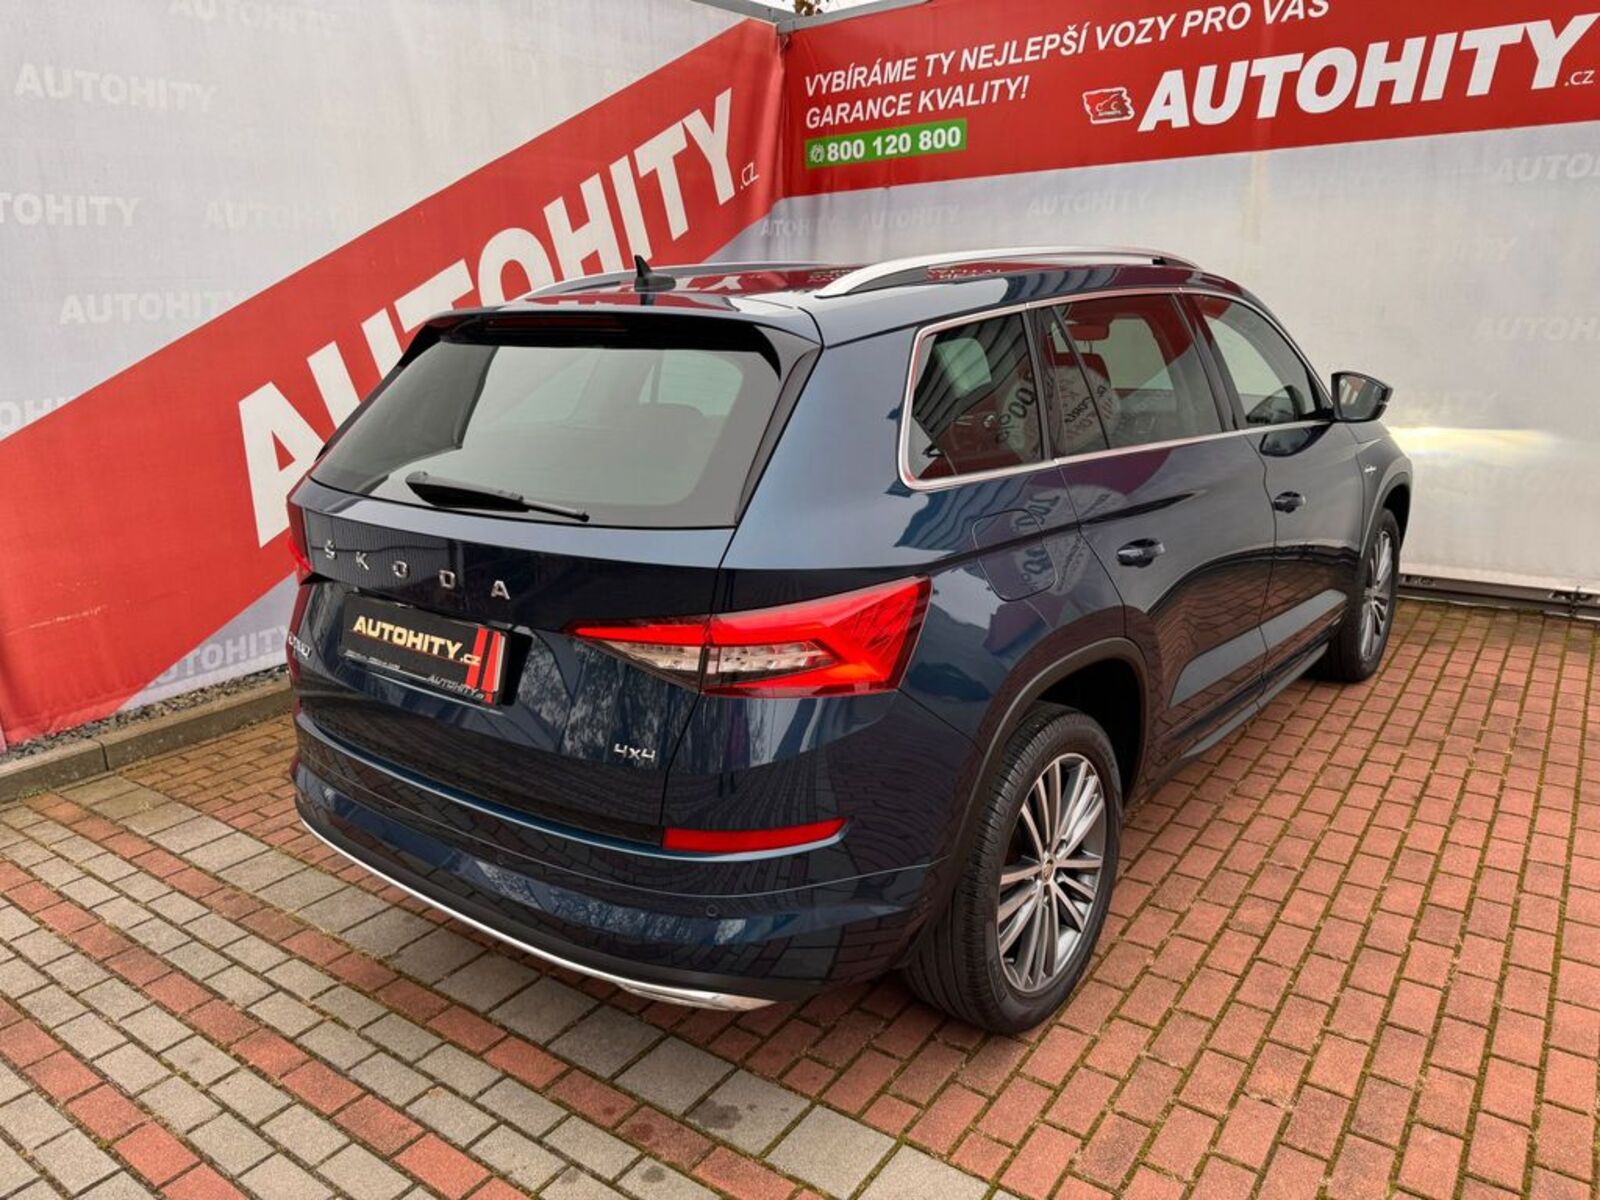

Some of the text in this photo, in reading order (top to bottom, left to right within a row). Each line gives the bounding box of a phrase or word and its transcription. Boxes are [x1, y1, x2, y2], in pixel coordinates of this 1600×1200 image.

[805, 57, 917, 97] VYBÍRÁME
[926, 51, 956, 77] TY
[960, 22, 1090, 72] NEJLEPŠÍ
[1096, 14, 1177, 50] VOZY
[1181, 2, 1251, 38] PRO
[14, 63, 218, 113] AUTOHITY
[806, 75, 1029, 129] GARANCE KVALITY!
[827, 126, 961, 162] 800 120 800
[1472, 316, 1600, 342] AUTOH
